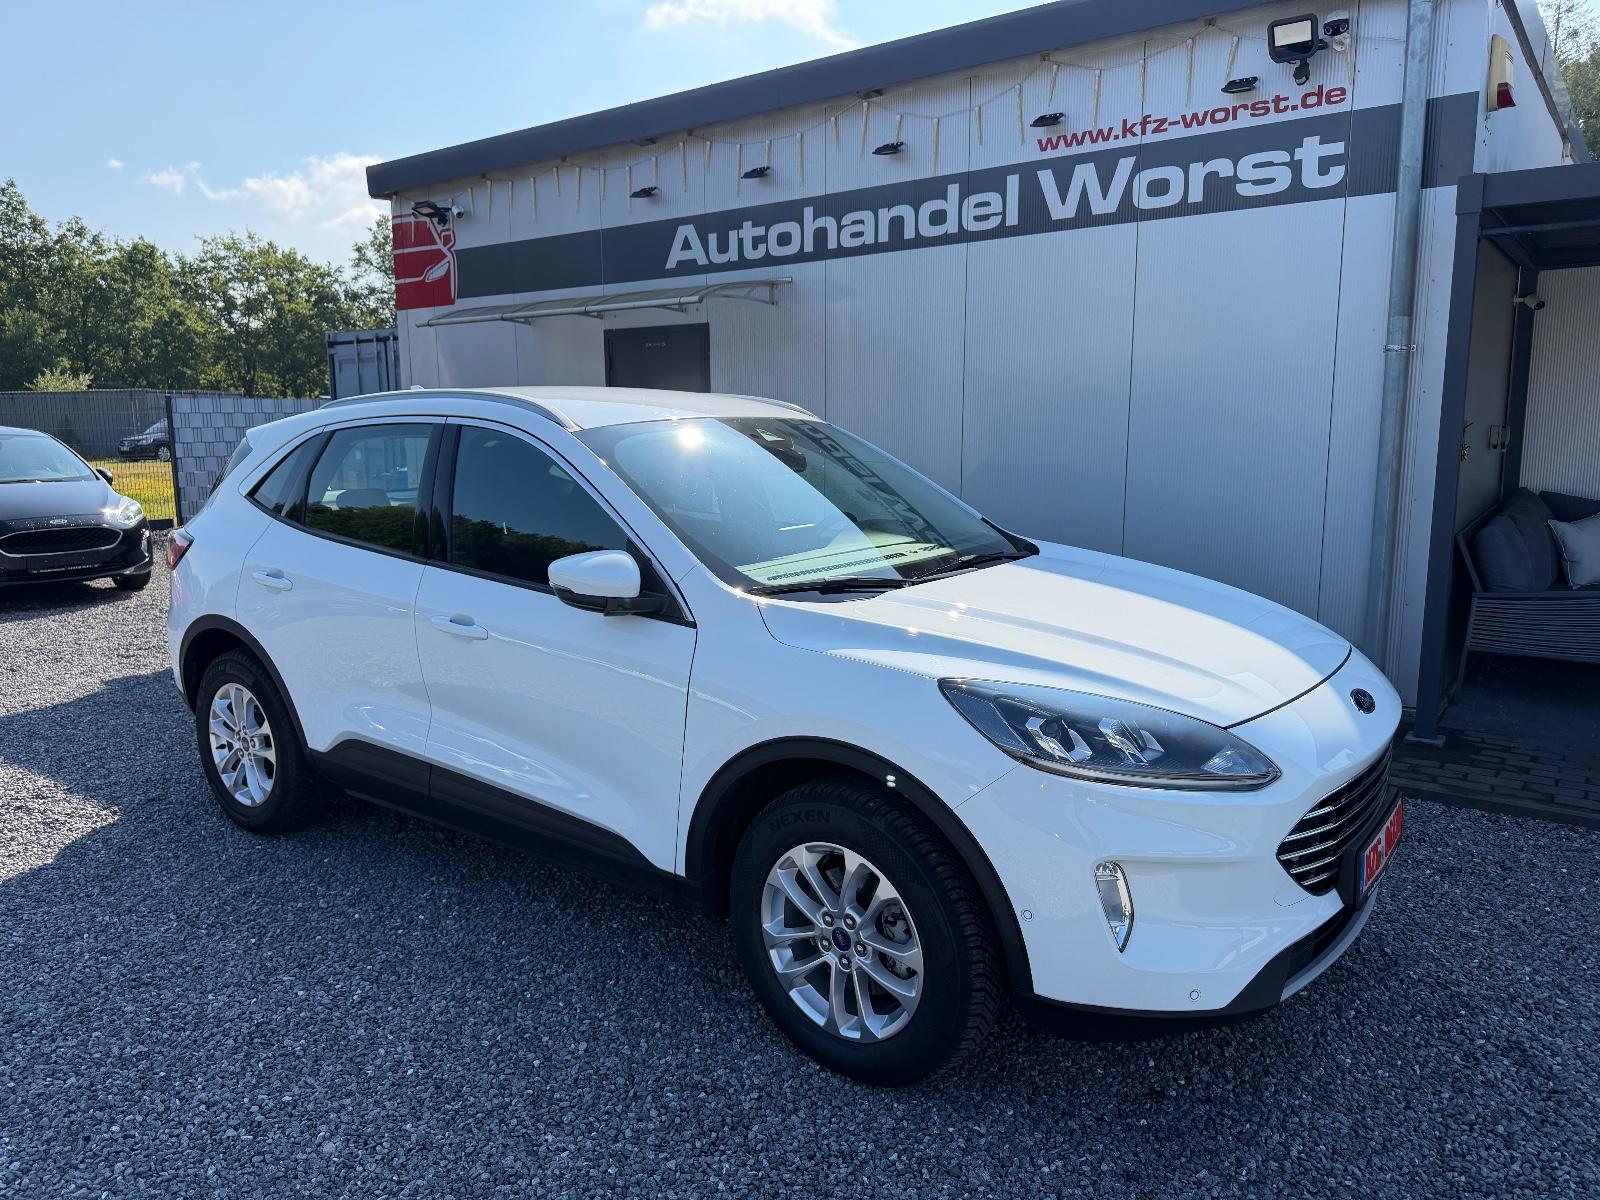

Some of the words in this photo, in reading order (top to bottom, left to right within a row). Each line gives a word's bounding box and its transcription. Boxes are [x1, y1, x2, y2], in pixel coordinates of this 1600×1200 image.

[1037, 84, 1347, 152] www.kfz-worst.de
[665, 174, 1019, 269] Autohandel
[1037, 136, 1345, 220] Worst
[769, 809, 831, 832] NEXEN
